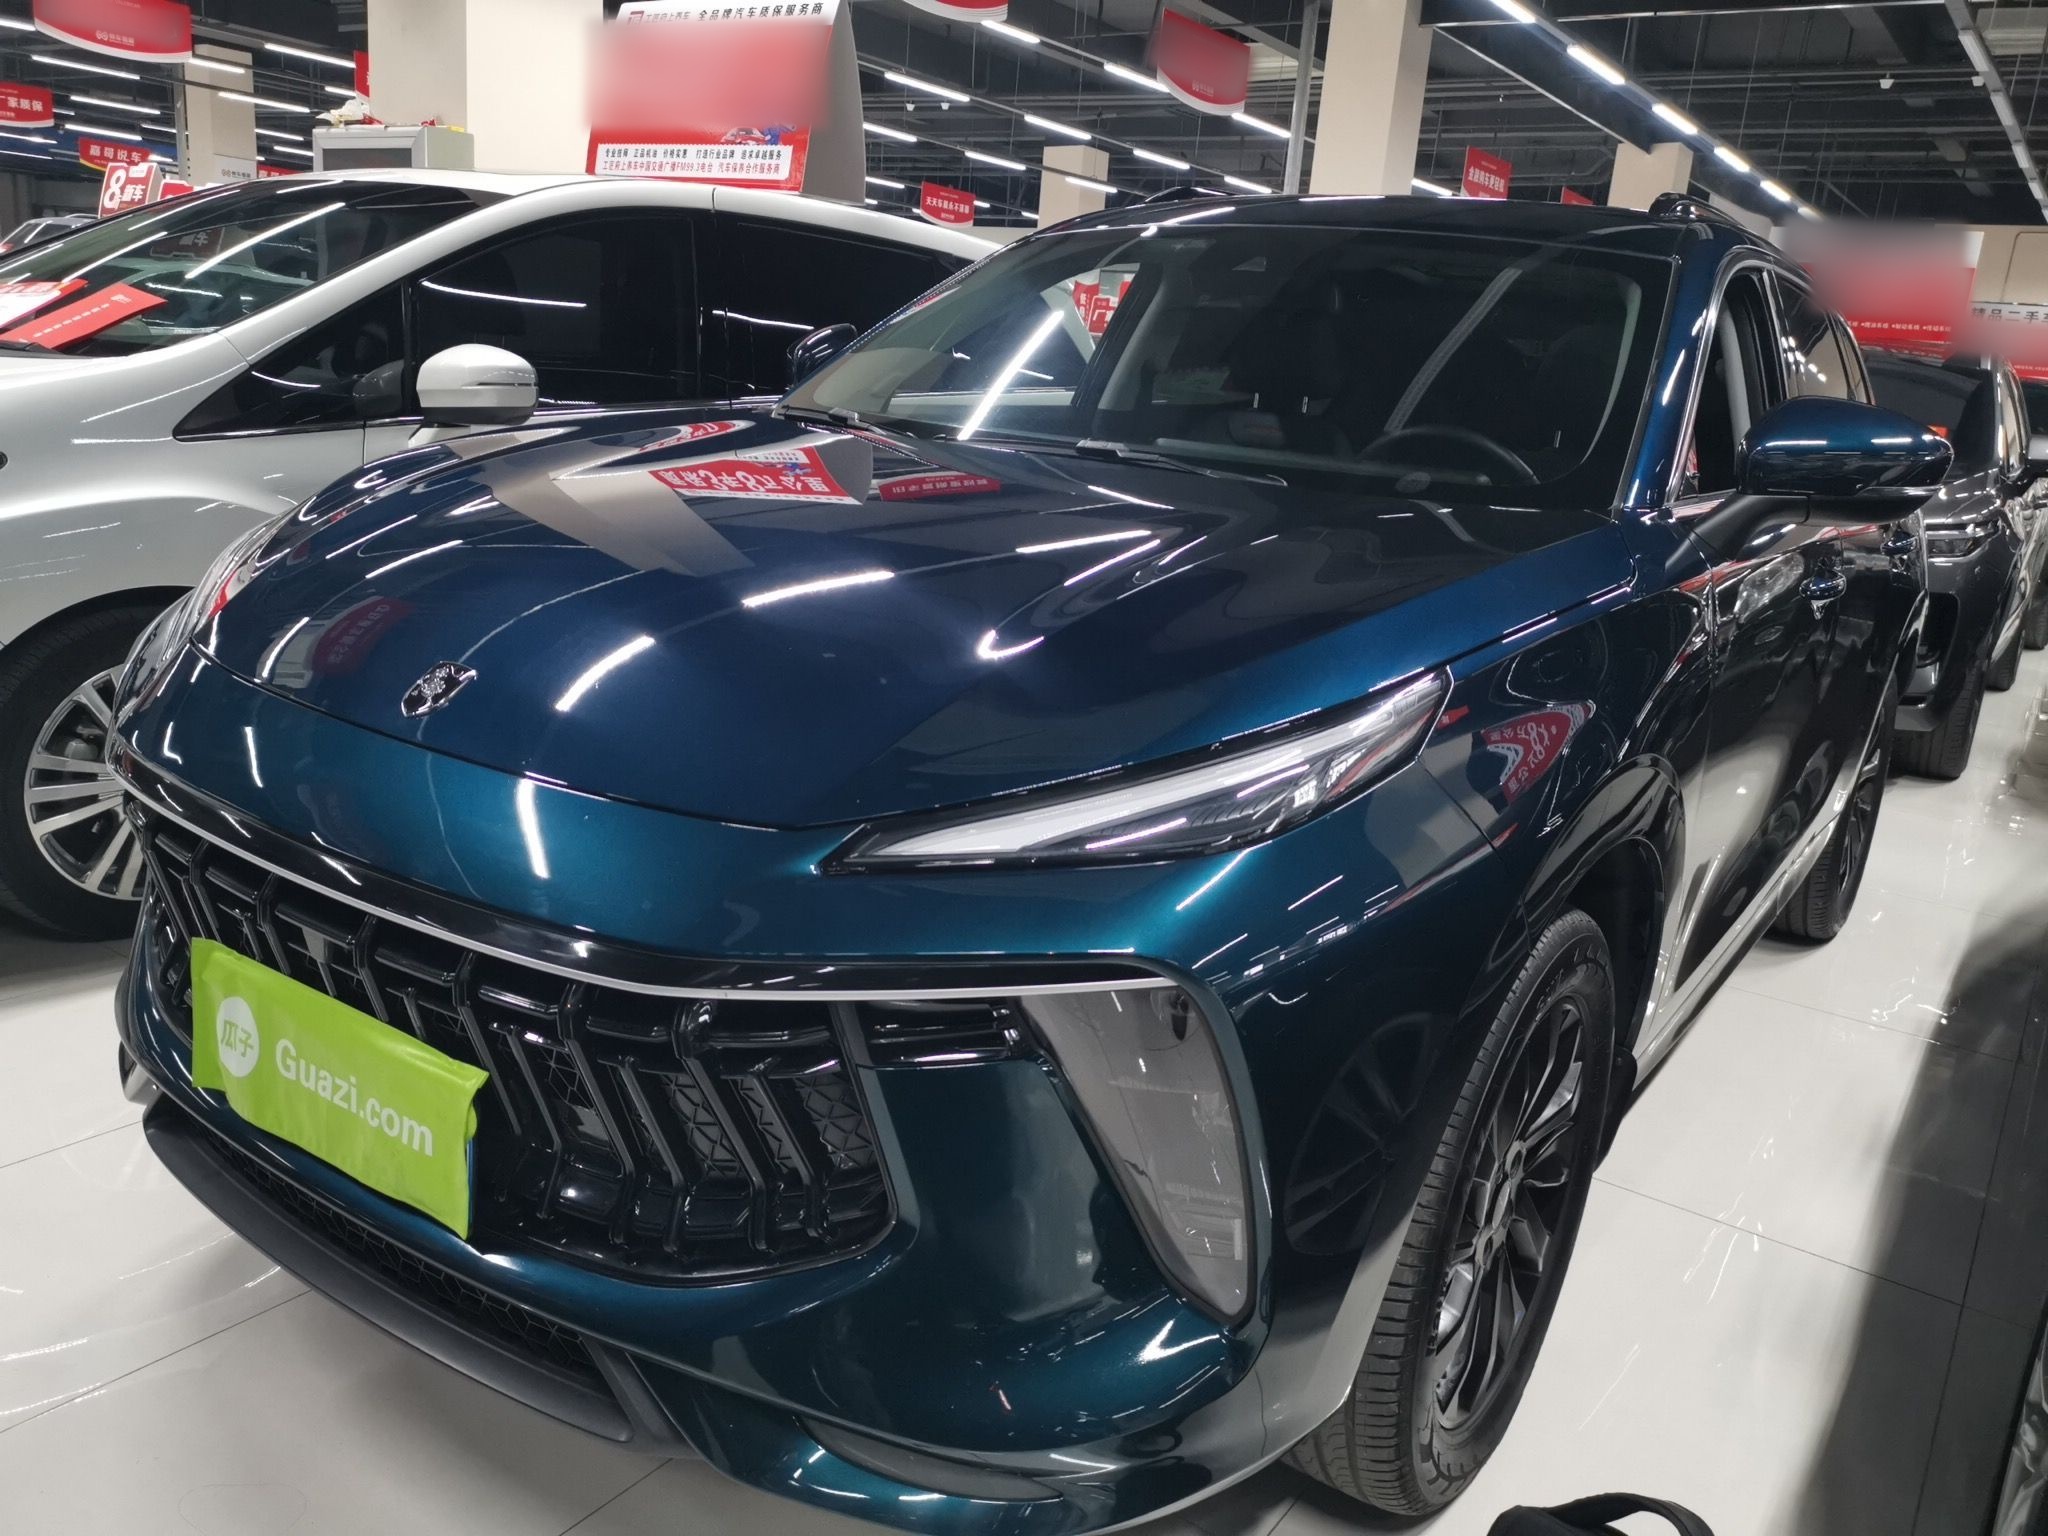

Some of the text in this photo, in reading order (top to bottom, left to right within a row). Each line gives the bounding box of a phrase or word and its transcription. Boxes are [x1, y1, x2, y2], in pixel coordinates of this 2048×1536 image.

[699, 2, 824, 21] 全品牌汽车质保服务商
[663, 148, 688, 159] 价格实惠
[696, 149, 735, 160] 打造行业品牌
[221, 1019, 254, 1058] 瓜子
[276, 1038, 433, 1157] Guazi.com
